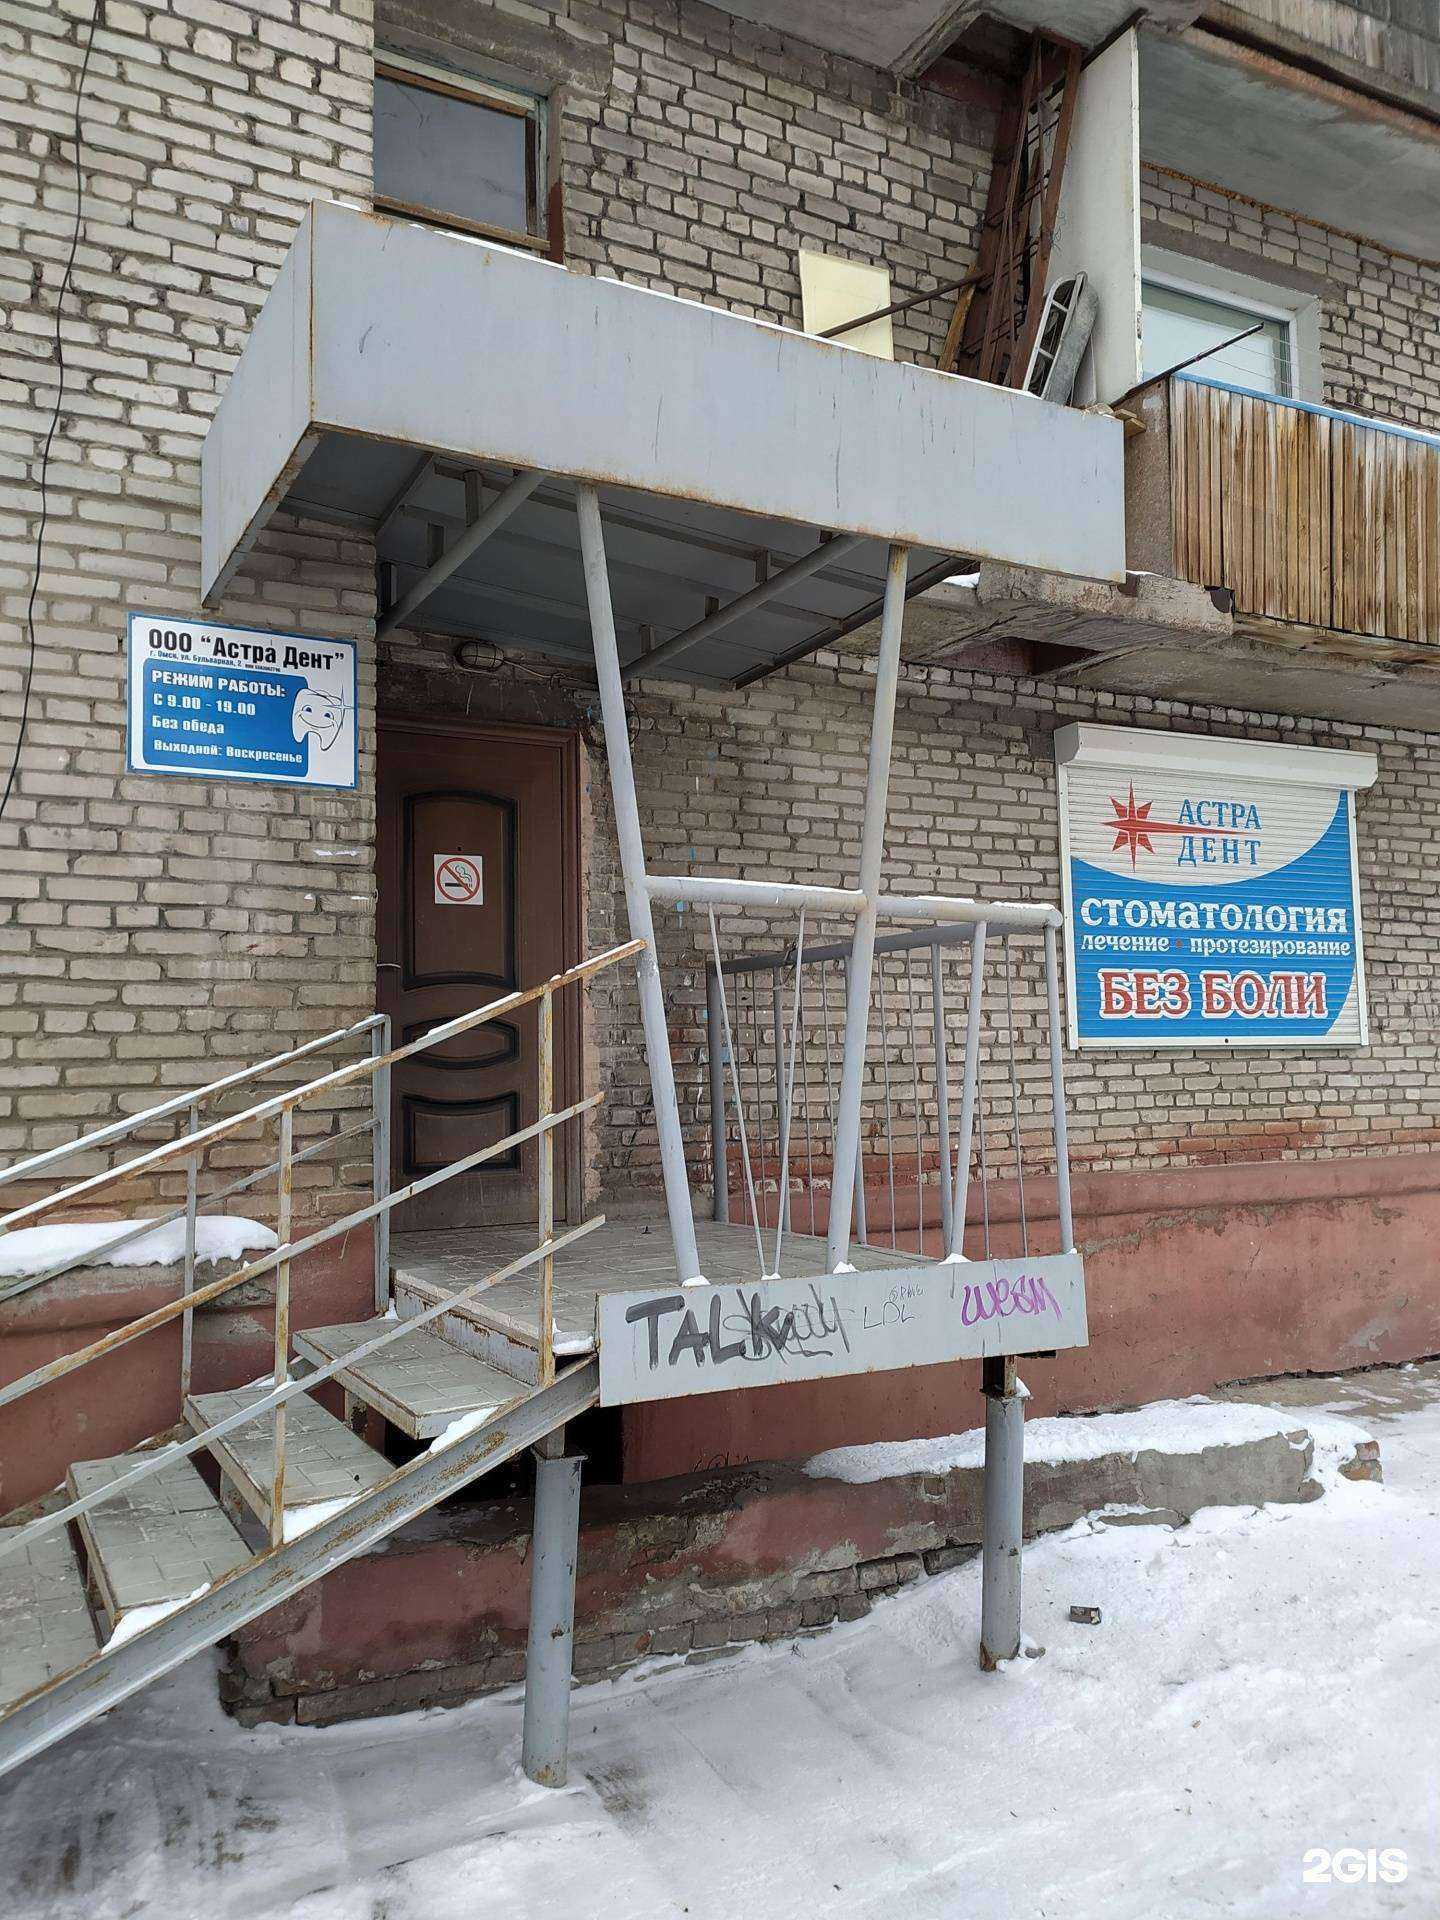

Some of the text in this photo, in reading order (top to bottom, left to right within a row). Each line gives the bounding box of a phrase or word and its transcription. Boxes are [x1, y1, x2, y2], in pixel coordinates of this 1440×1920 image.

[149, 628, 192, 653] ООО
[151, 670, 286, 698] РЕЖИМ РАБОТЫ:
[167, 695, 201, 710] 9.00
[215, 700, 256, 716] 19.00
[151, 715, 225, 735] Без обеда
[153, 740, 303, 763] Выходной: Воскресенье
[1177, 798, 1262, 830] АСТРА
[1177, 835, 1261, 867] ДЕНТ
[1081, 934, 1351, 959] лечение протезирование
[1099, 969, 1328, 1018] БЕЗ БОЛИ
